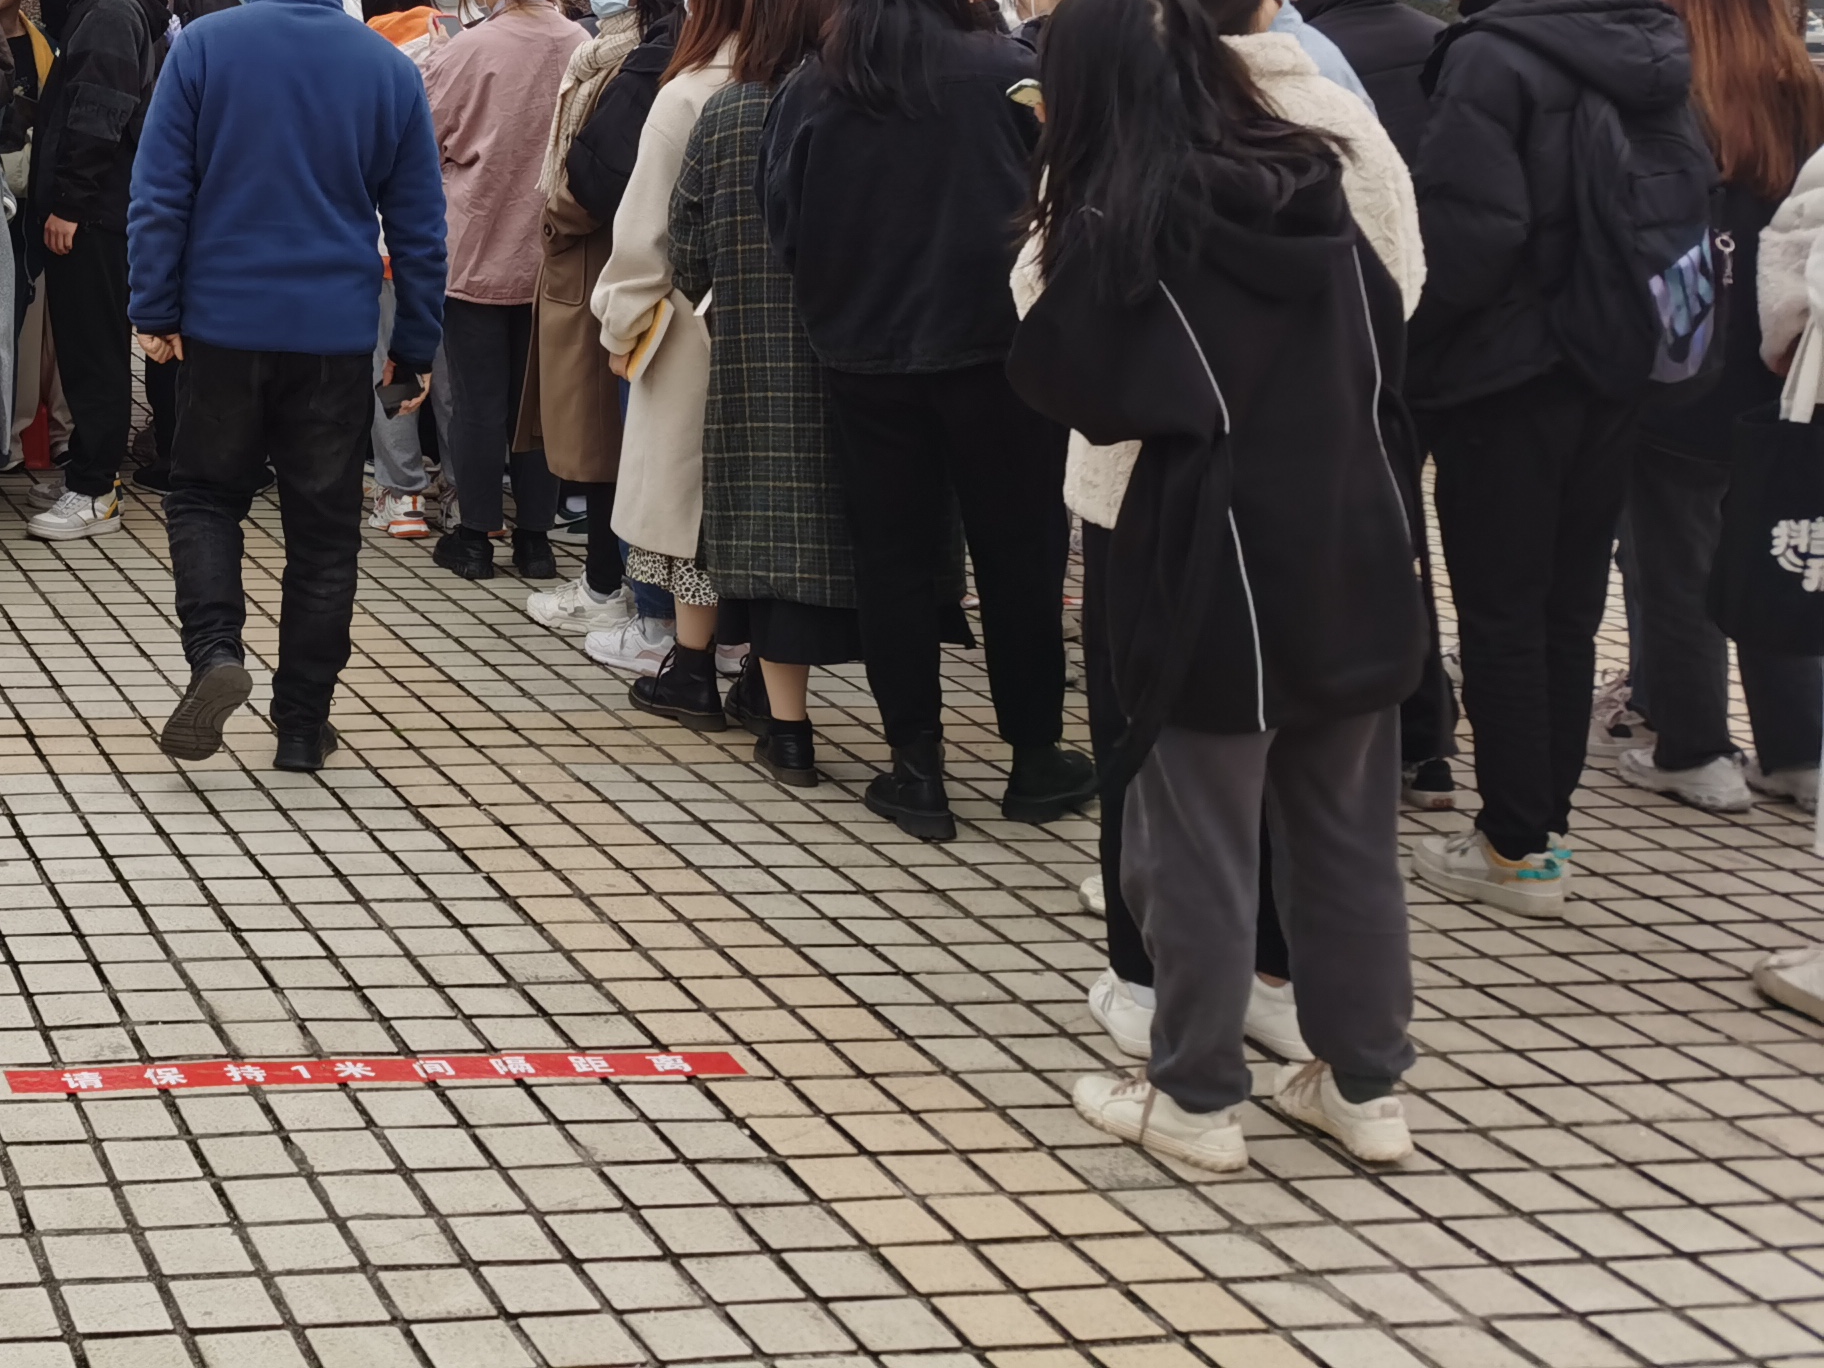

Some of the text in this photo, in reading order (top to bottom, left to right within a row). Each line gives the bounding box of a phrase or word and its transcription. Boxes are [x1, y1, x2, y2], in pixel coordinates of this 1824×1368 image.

[61, 1054, 692, 1089] 请保持1米间隔距离
